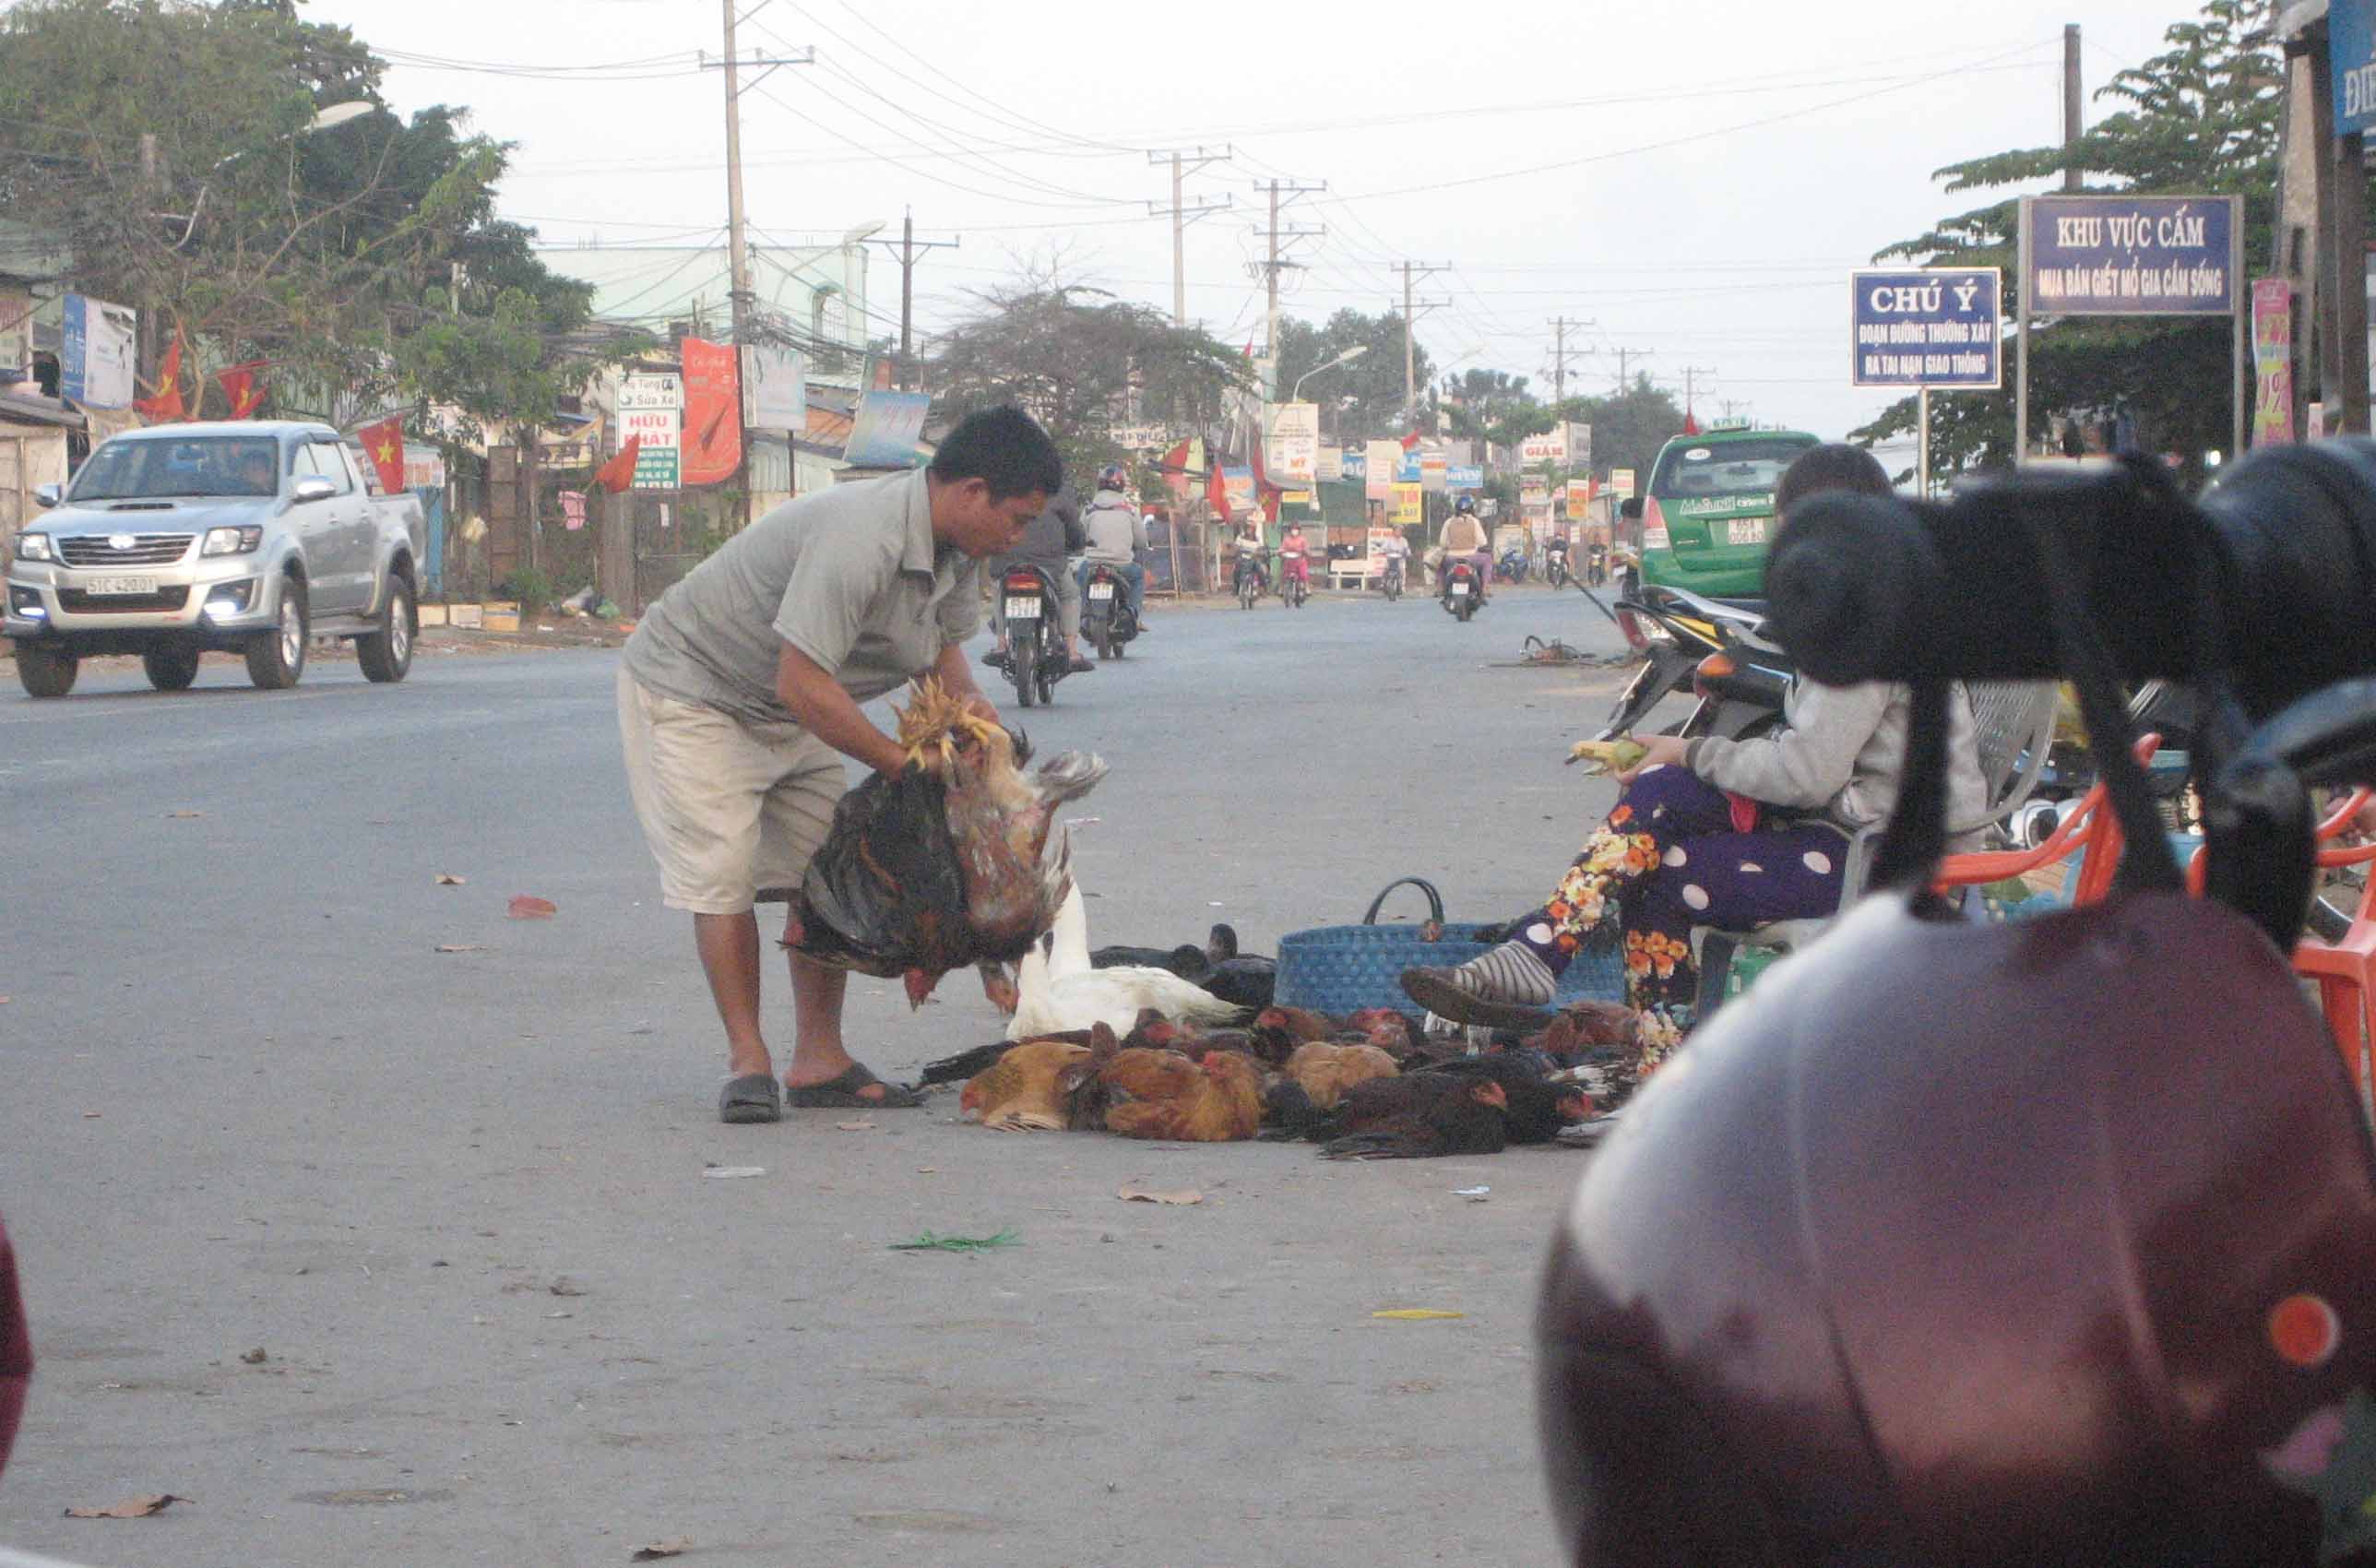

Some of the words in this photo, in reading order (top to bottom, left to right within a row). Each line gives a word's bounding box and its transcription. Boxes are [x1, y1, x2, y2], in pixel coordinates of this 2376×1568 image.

[2057, 217, 2102, 247] KHU
[2108, 211, 2152, 254] VỰC
[2157, 204, 2204, 247] CẤM
[1871, 279, 1942, 313] CHÚ
[1954, 278, 1978, 312] Ý
[2038, 268, 2064, 296] MUA
[2066, 263, 2090, 296] BÁN
[2141, 268, 2161, 296] GIA
[1865, 354, 1880, 374] RA
[1882, 354, 1898, 374] TAI
[1900, 354, 1923, 379] NẠN
[1925, 354, 1950, 374] GIAO
